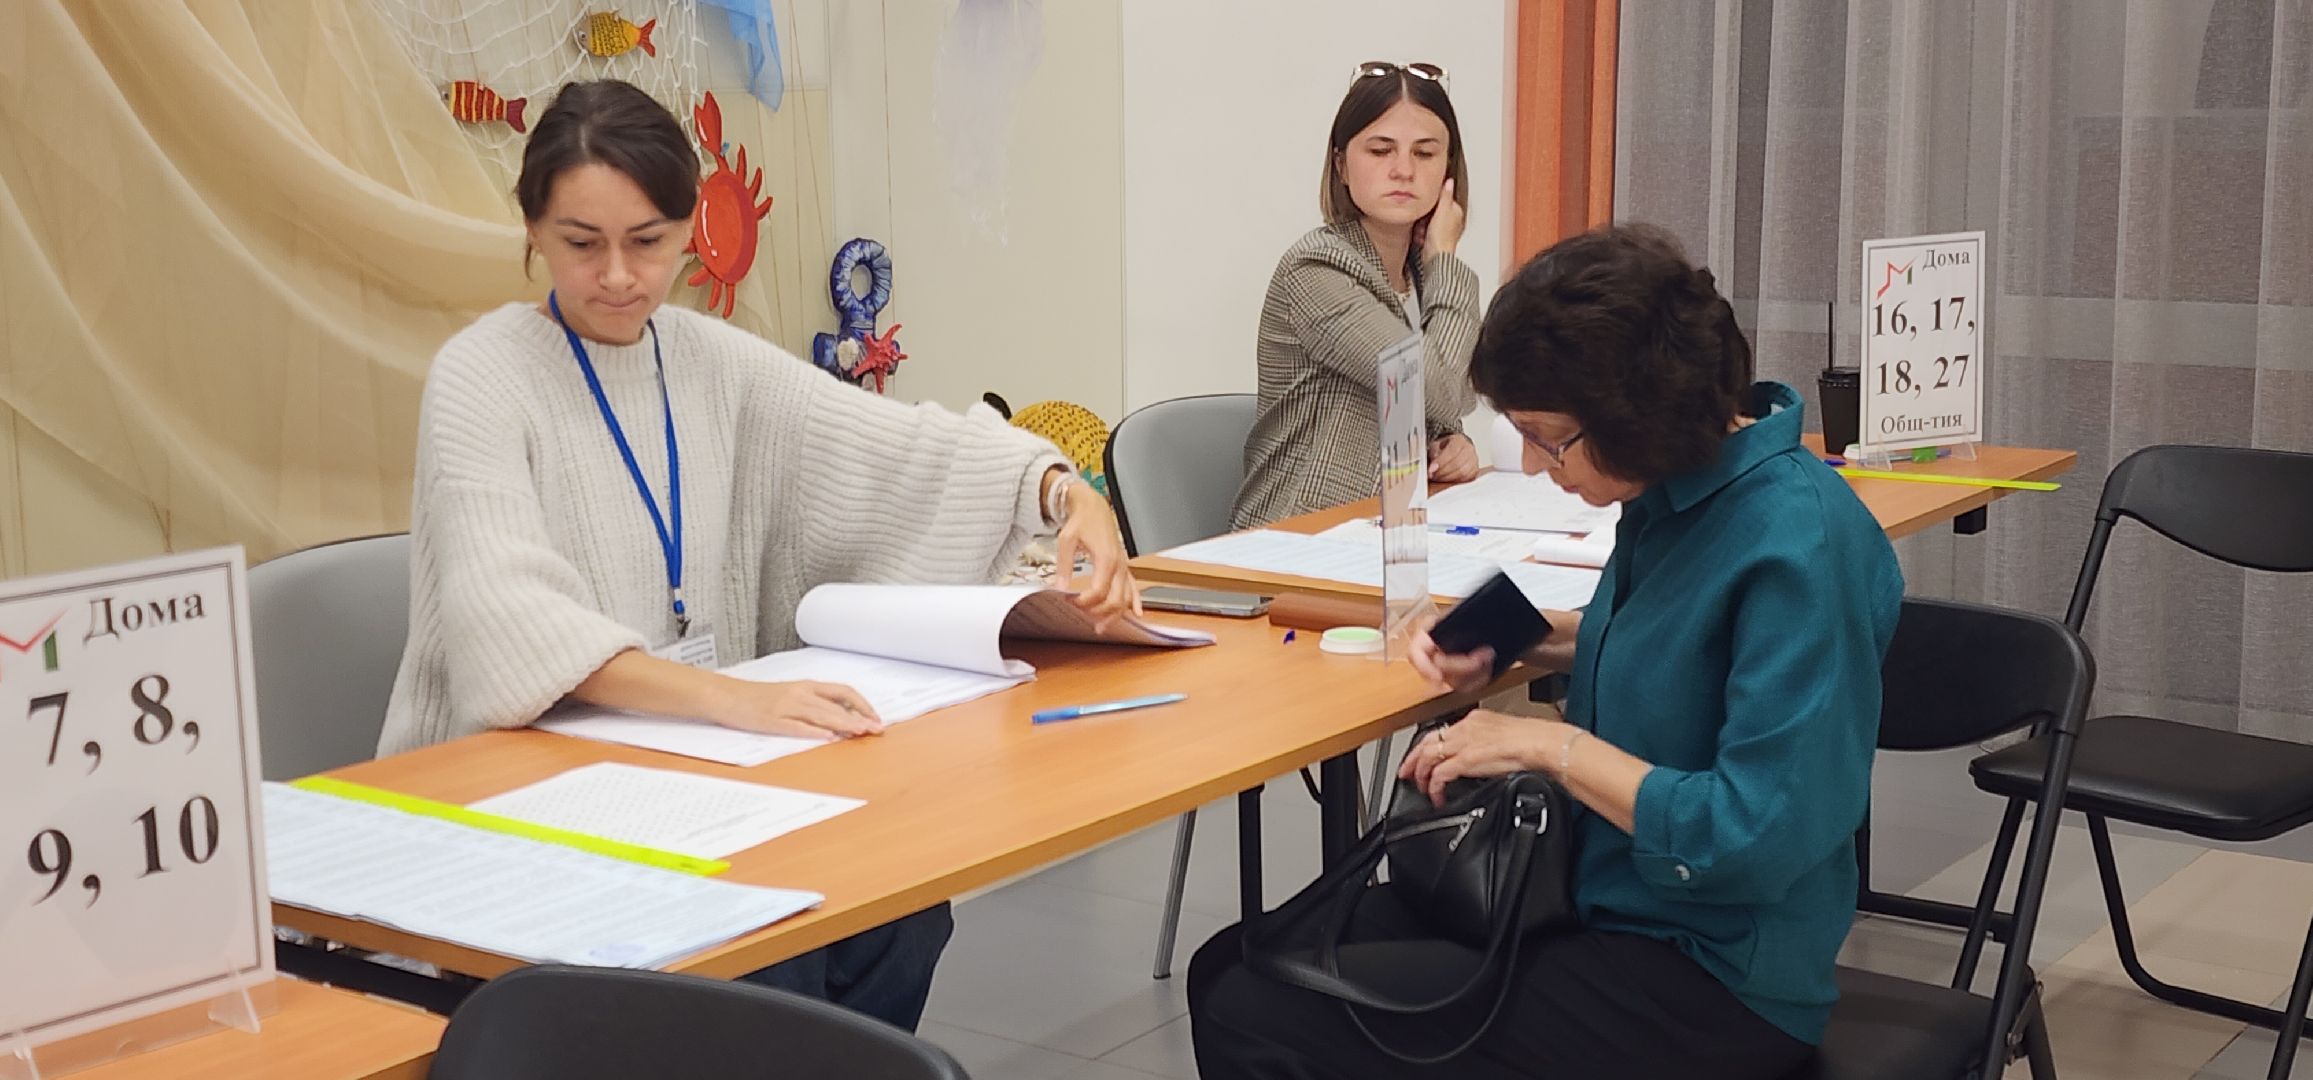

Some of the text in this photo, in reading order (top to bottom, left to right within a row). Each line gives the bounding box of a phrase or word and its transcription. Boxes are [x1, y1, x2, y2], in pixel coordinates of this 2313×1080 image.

[1922, 250, 1970, 270] Дома
[1872, 296, 1975, 342] 16, 17,
[1876, 354, 1969, 400] 18, 27
[1881, 414, 1963, 434] Общ-тия
[83, 593, 206, 643] Дома
[28, 674, 200, 774] 7, 8,
[28, 829, 101, 908] 9,
[133, 795, 219, 879] 10
